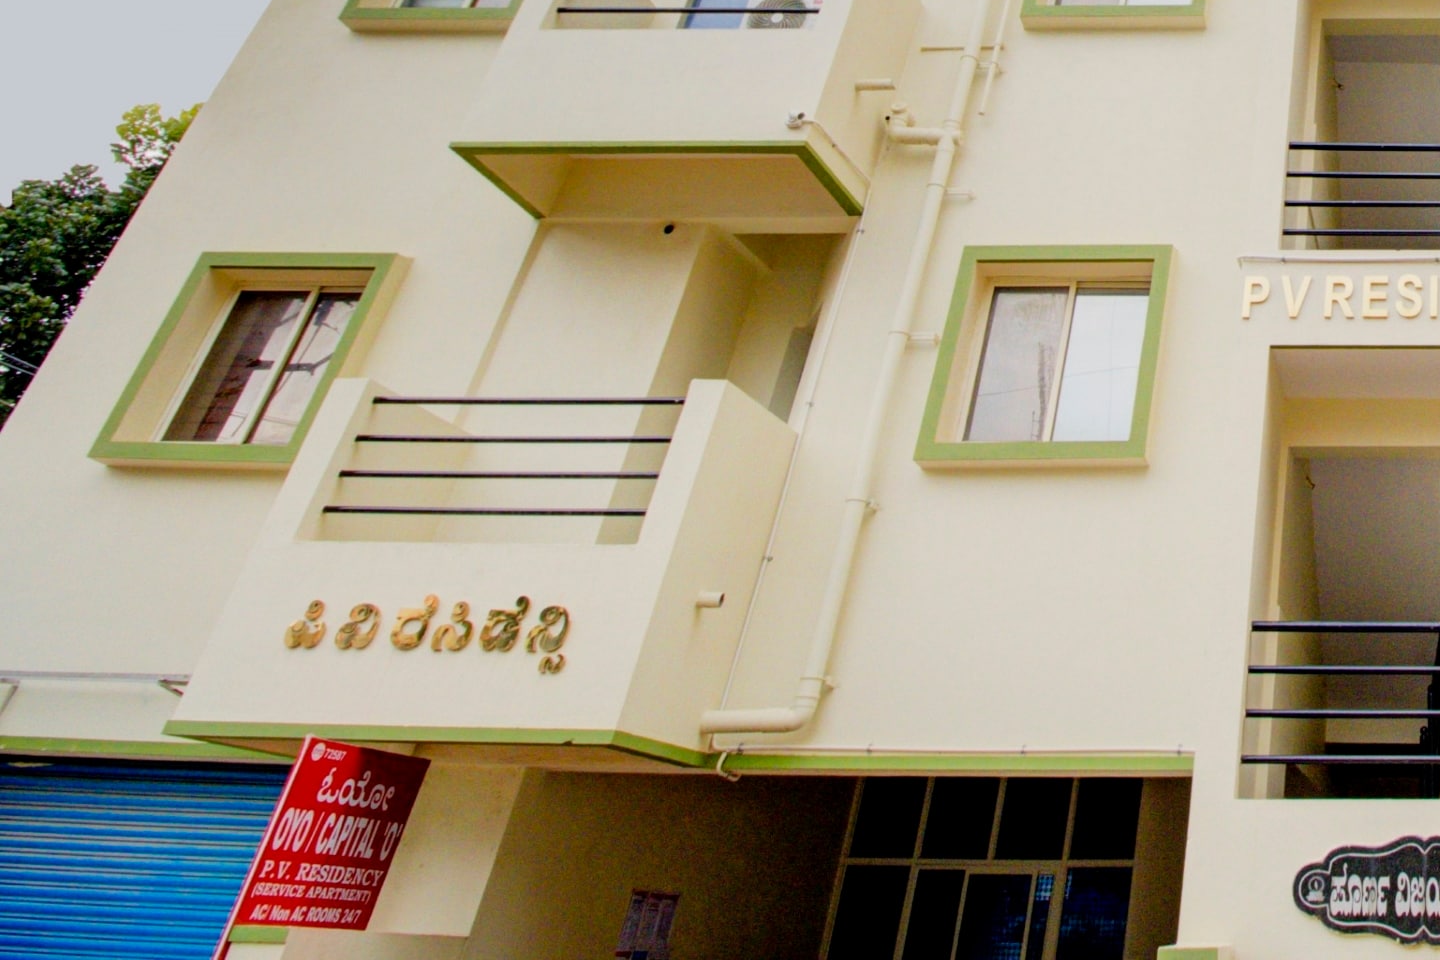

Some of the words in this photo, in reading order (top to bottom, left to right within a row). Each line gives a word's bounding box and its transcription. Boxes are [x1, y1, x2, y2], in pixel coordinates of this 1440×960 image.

[259, 860, 291, 880] P.V.
[295, 863, 384, 887] RESIDENCY
[251, 882, 306, 898] (SERVICE
[290, 906, 308, 922] AC
[305, 906, 342, 924] ROOMS
